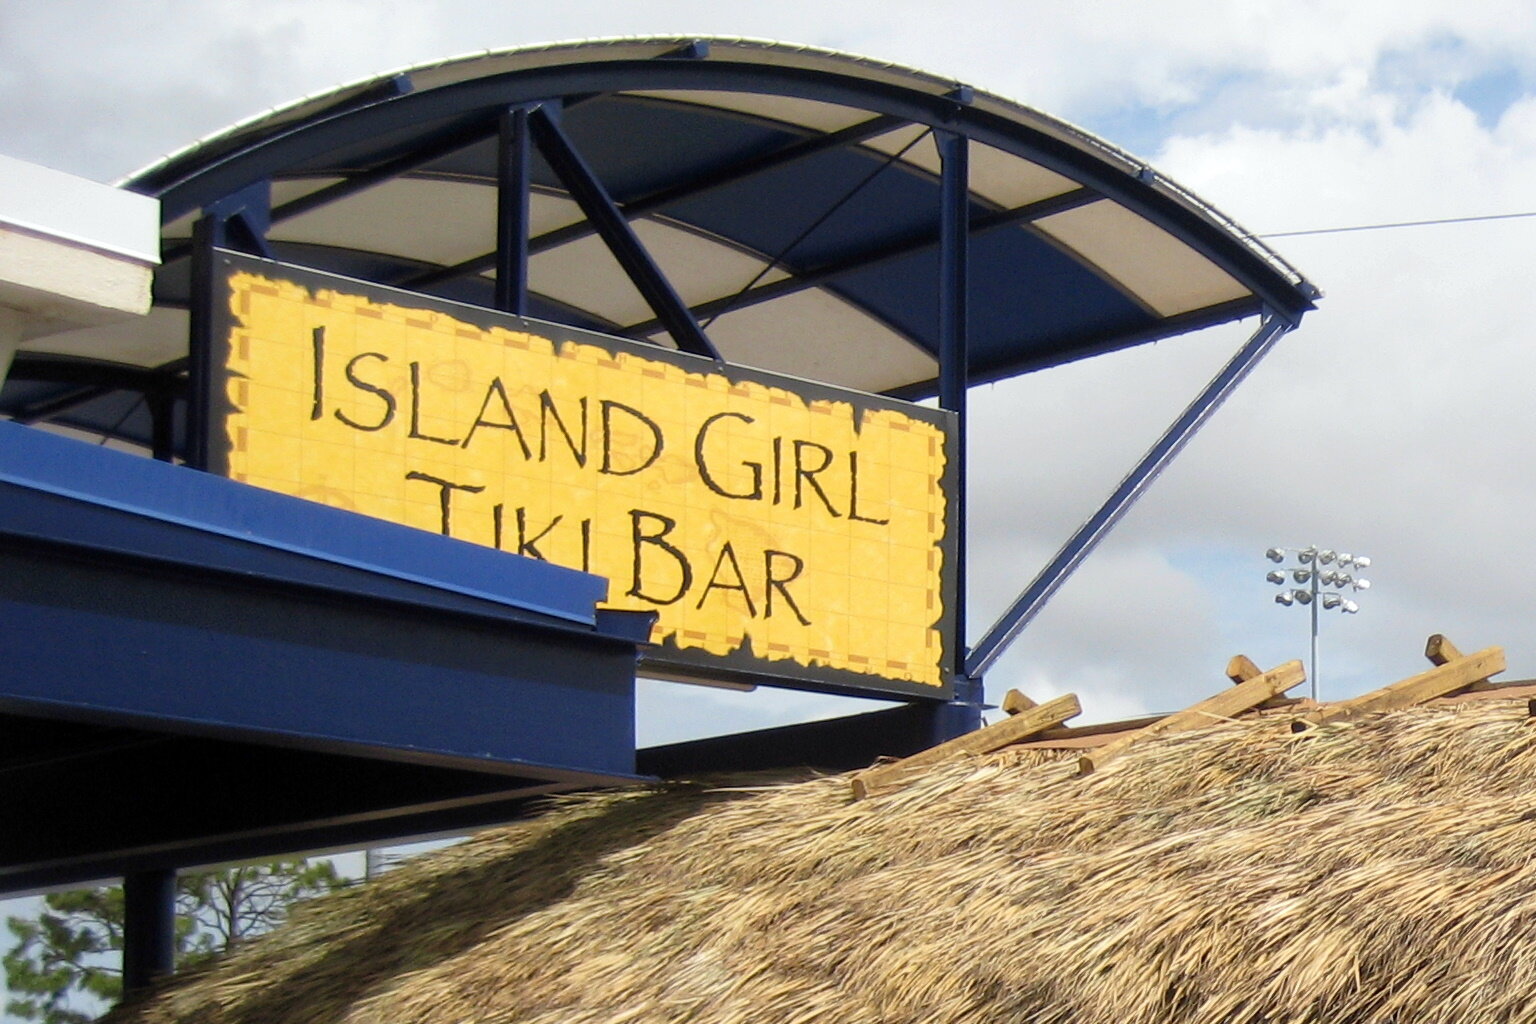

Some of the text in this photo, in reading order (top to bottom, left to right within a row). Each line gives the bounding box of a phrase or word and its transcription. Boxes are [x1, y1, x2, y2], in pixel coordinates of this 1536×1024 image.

[311, 326, 889, 525] ISLAND GIRL
[626, 509, 812, 626] BAR
